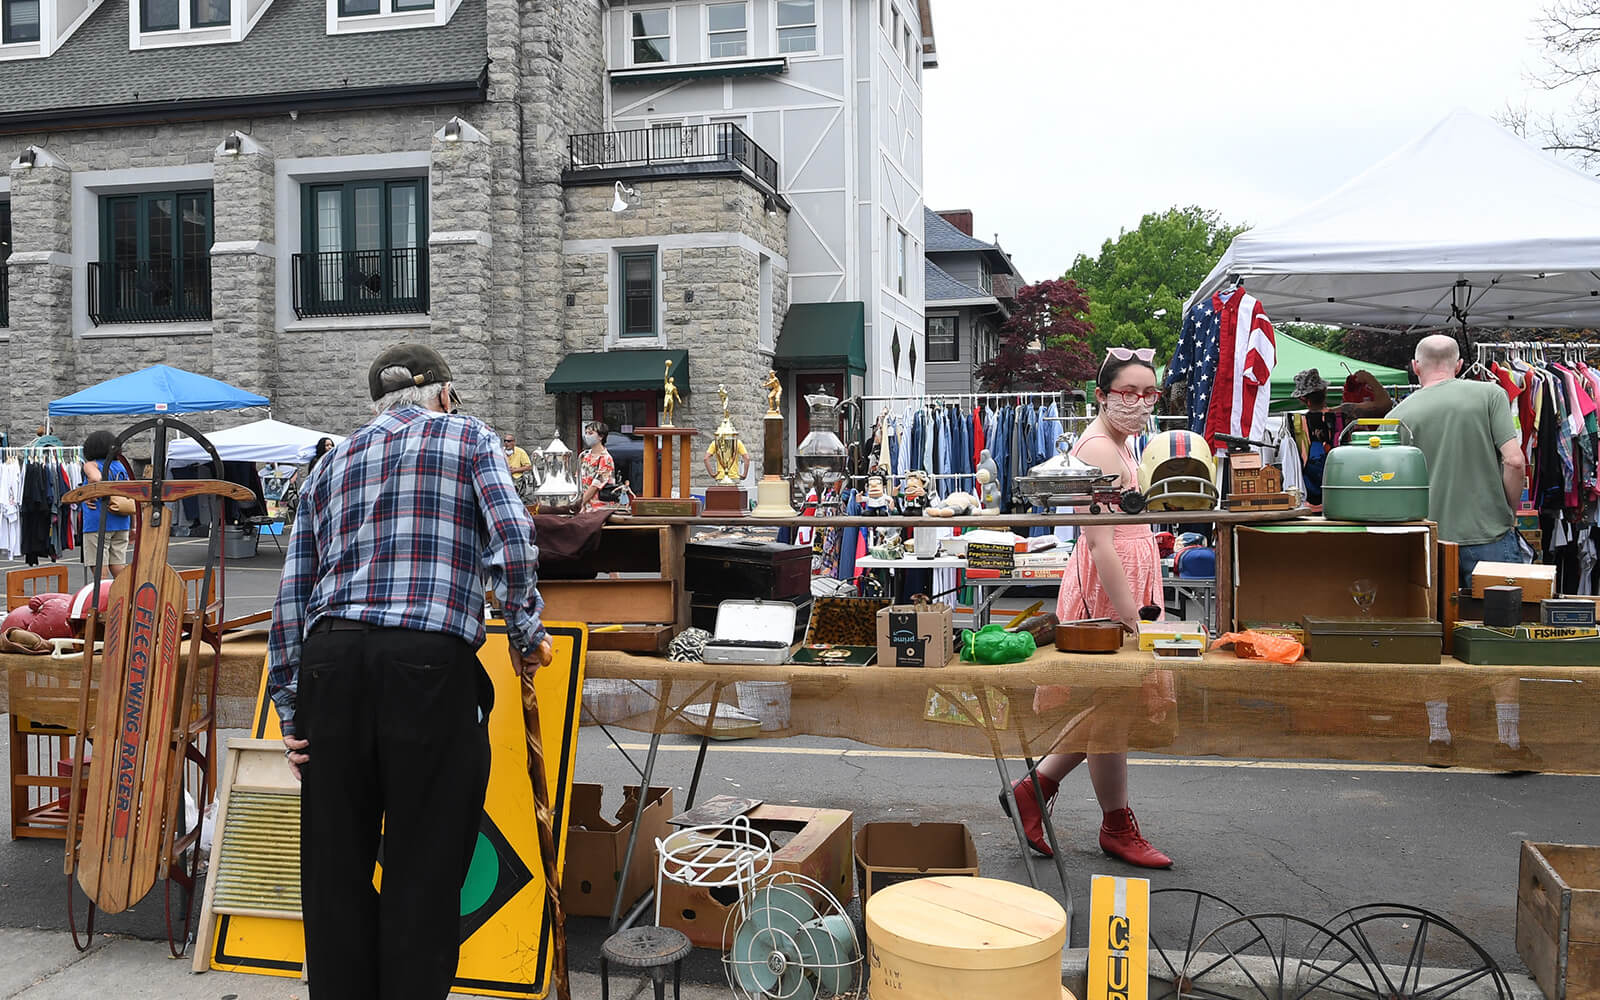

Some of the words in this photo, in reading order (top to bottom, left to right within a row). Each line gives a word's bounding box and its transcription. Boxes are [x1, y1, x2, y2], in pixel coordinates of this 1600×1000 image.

[893, 635, 915, 645] prime
[1534, 628, 1576, 638] FISHING
[126, 605, 153, 733] FLEETWING
[117, 743, 136, 812] RACER
[1108, 915, 1129, 1000] CU
